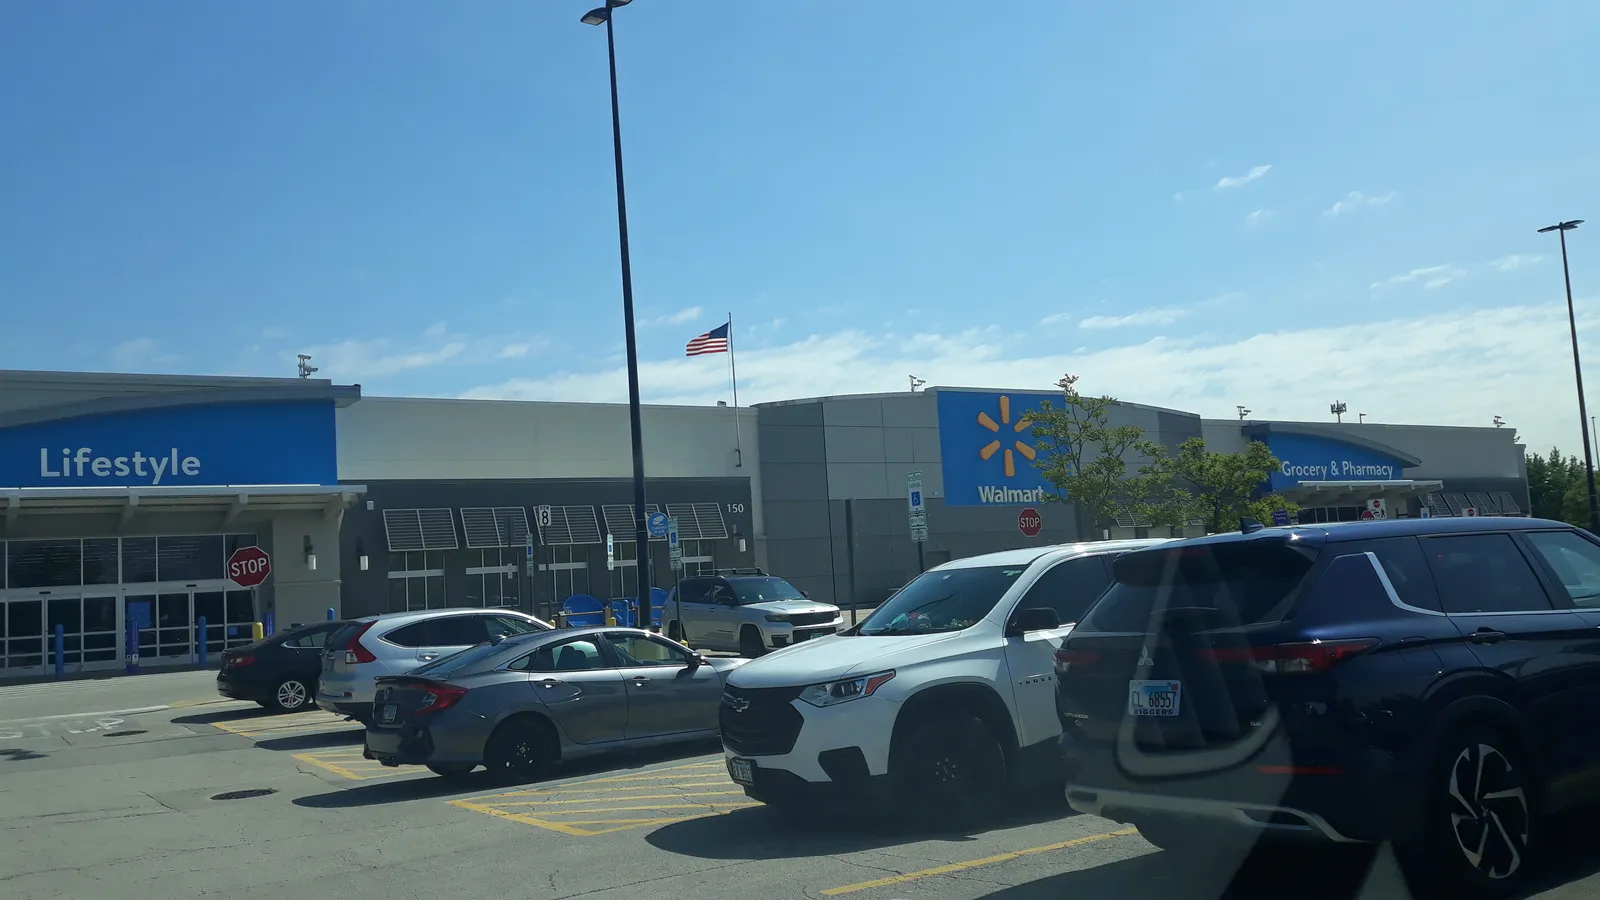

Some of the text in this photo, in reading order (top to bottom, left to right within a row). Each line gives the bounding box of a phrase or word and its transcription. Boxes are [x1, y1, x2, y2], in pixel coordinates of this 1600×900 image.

[40, 448, 201, 485] Lifestyle
[1282, 461, 1393, 480] Grocery & Pharmacy
[977, 485, 1044, 503] Walmart
[726, 503, 744, 513] 150
[542, 510, 549, 525] 8
[1020, 517, 1040, 528] STOP
[230, 557, 268, 577] STOP
[1132, 690, 1177, 709] CL 68557
